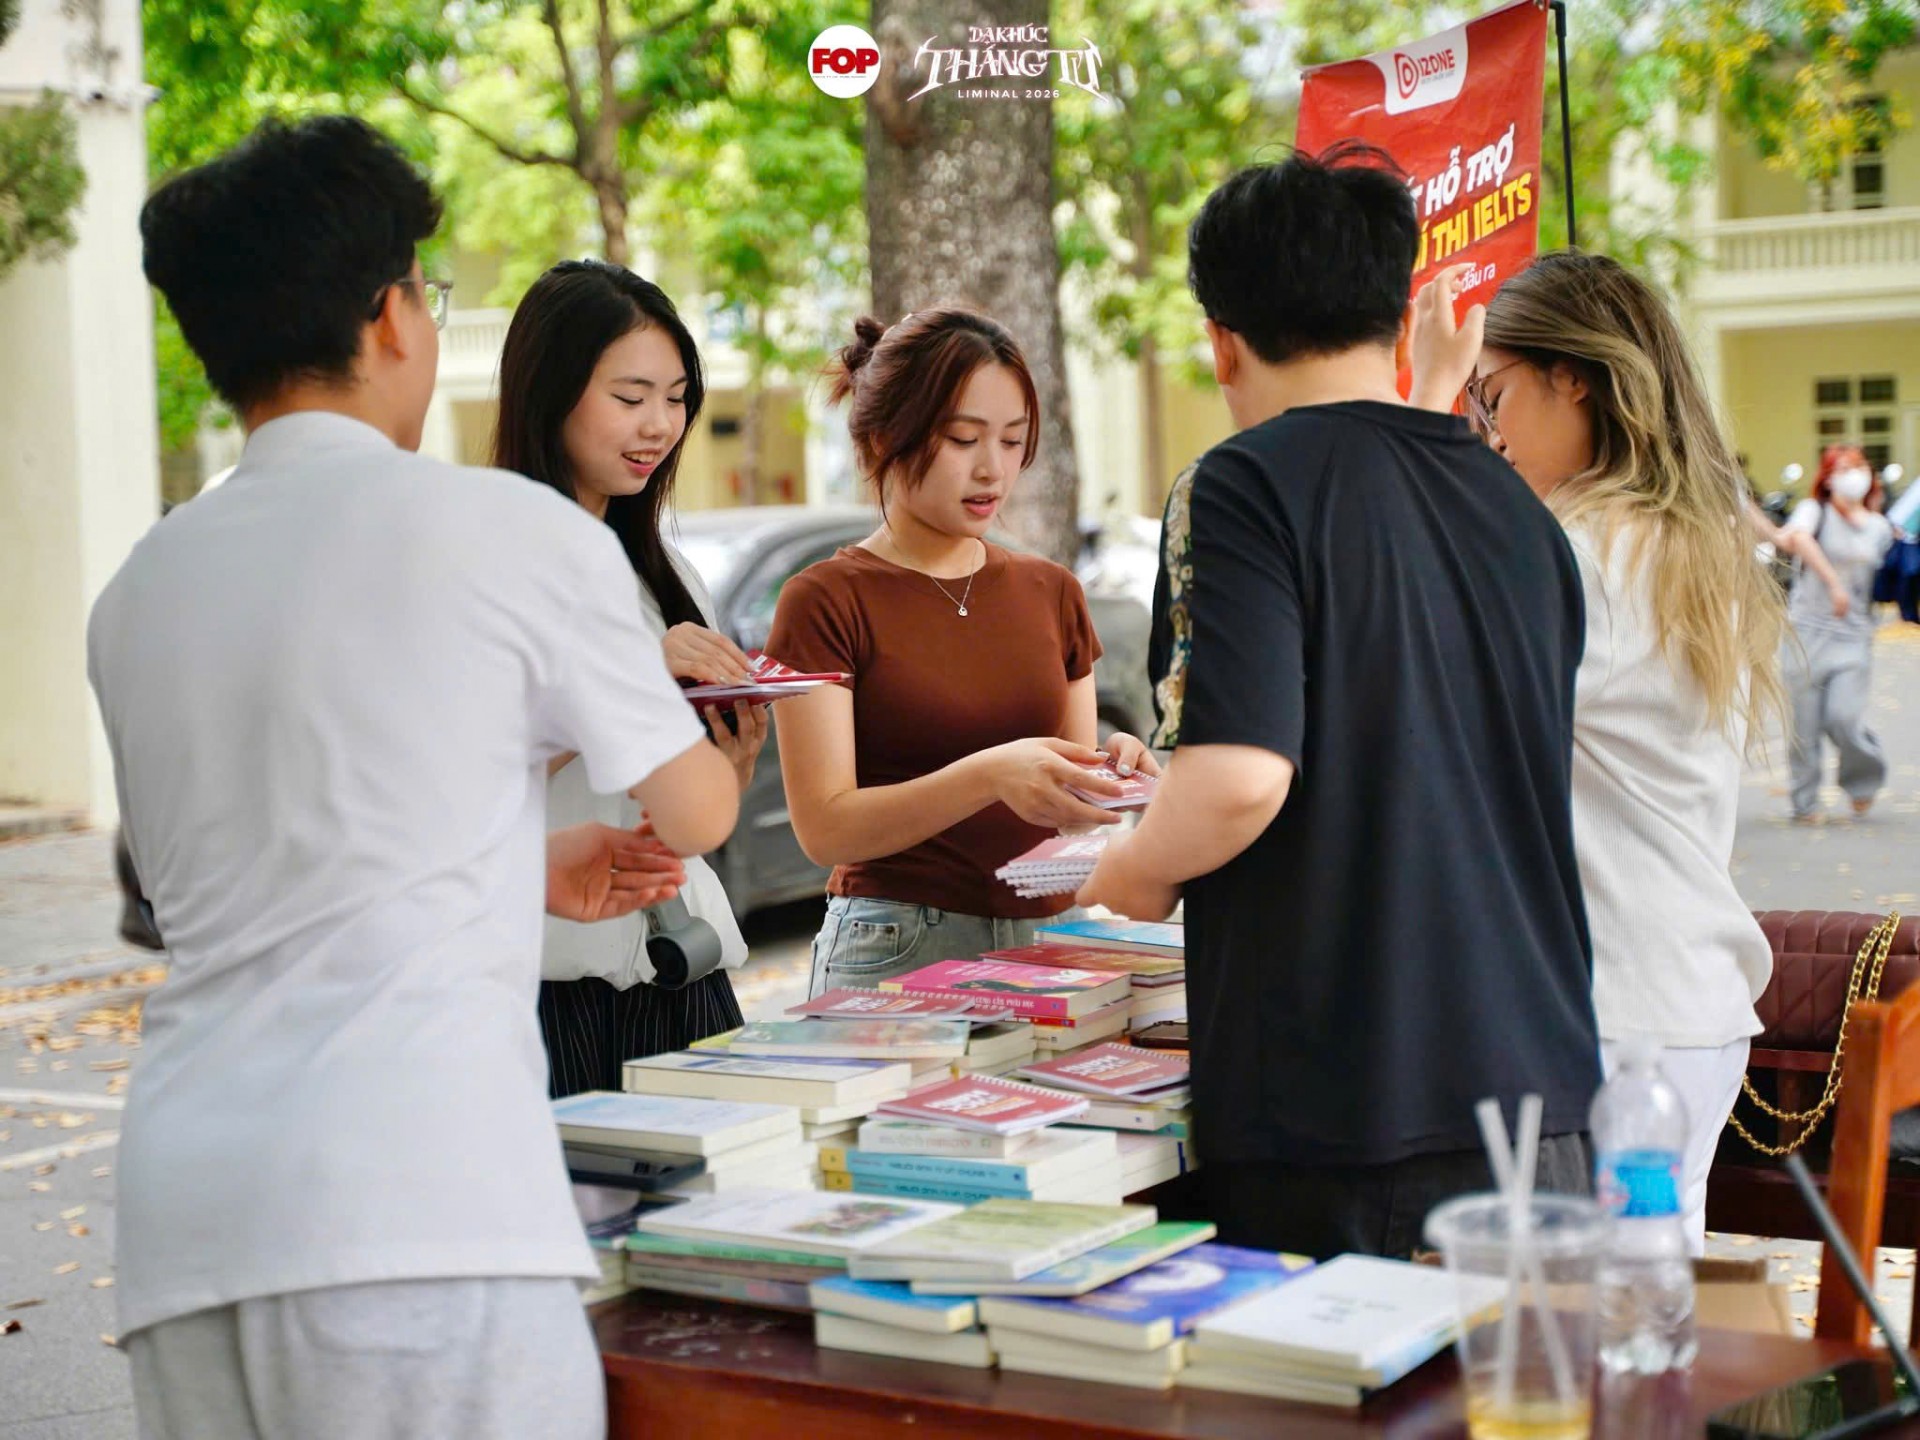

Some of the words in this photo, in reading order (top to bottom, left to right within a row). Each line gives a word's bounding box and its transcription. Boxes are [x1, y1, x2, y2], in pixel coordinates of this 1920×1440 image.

[1425, 145, 1462, 217] HỖ
[1466, 122, 1515, 193] TRỢ
[1432, 208, 1469, 263] THI
[1473, 171, 1532, 242] IELTS
[1483, 262, 1496, 282] ra
